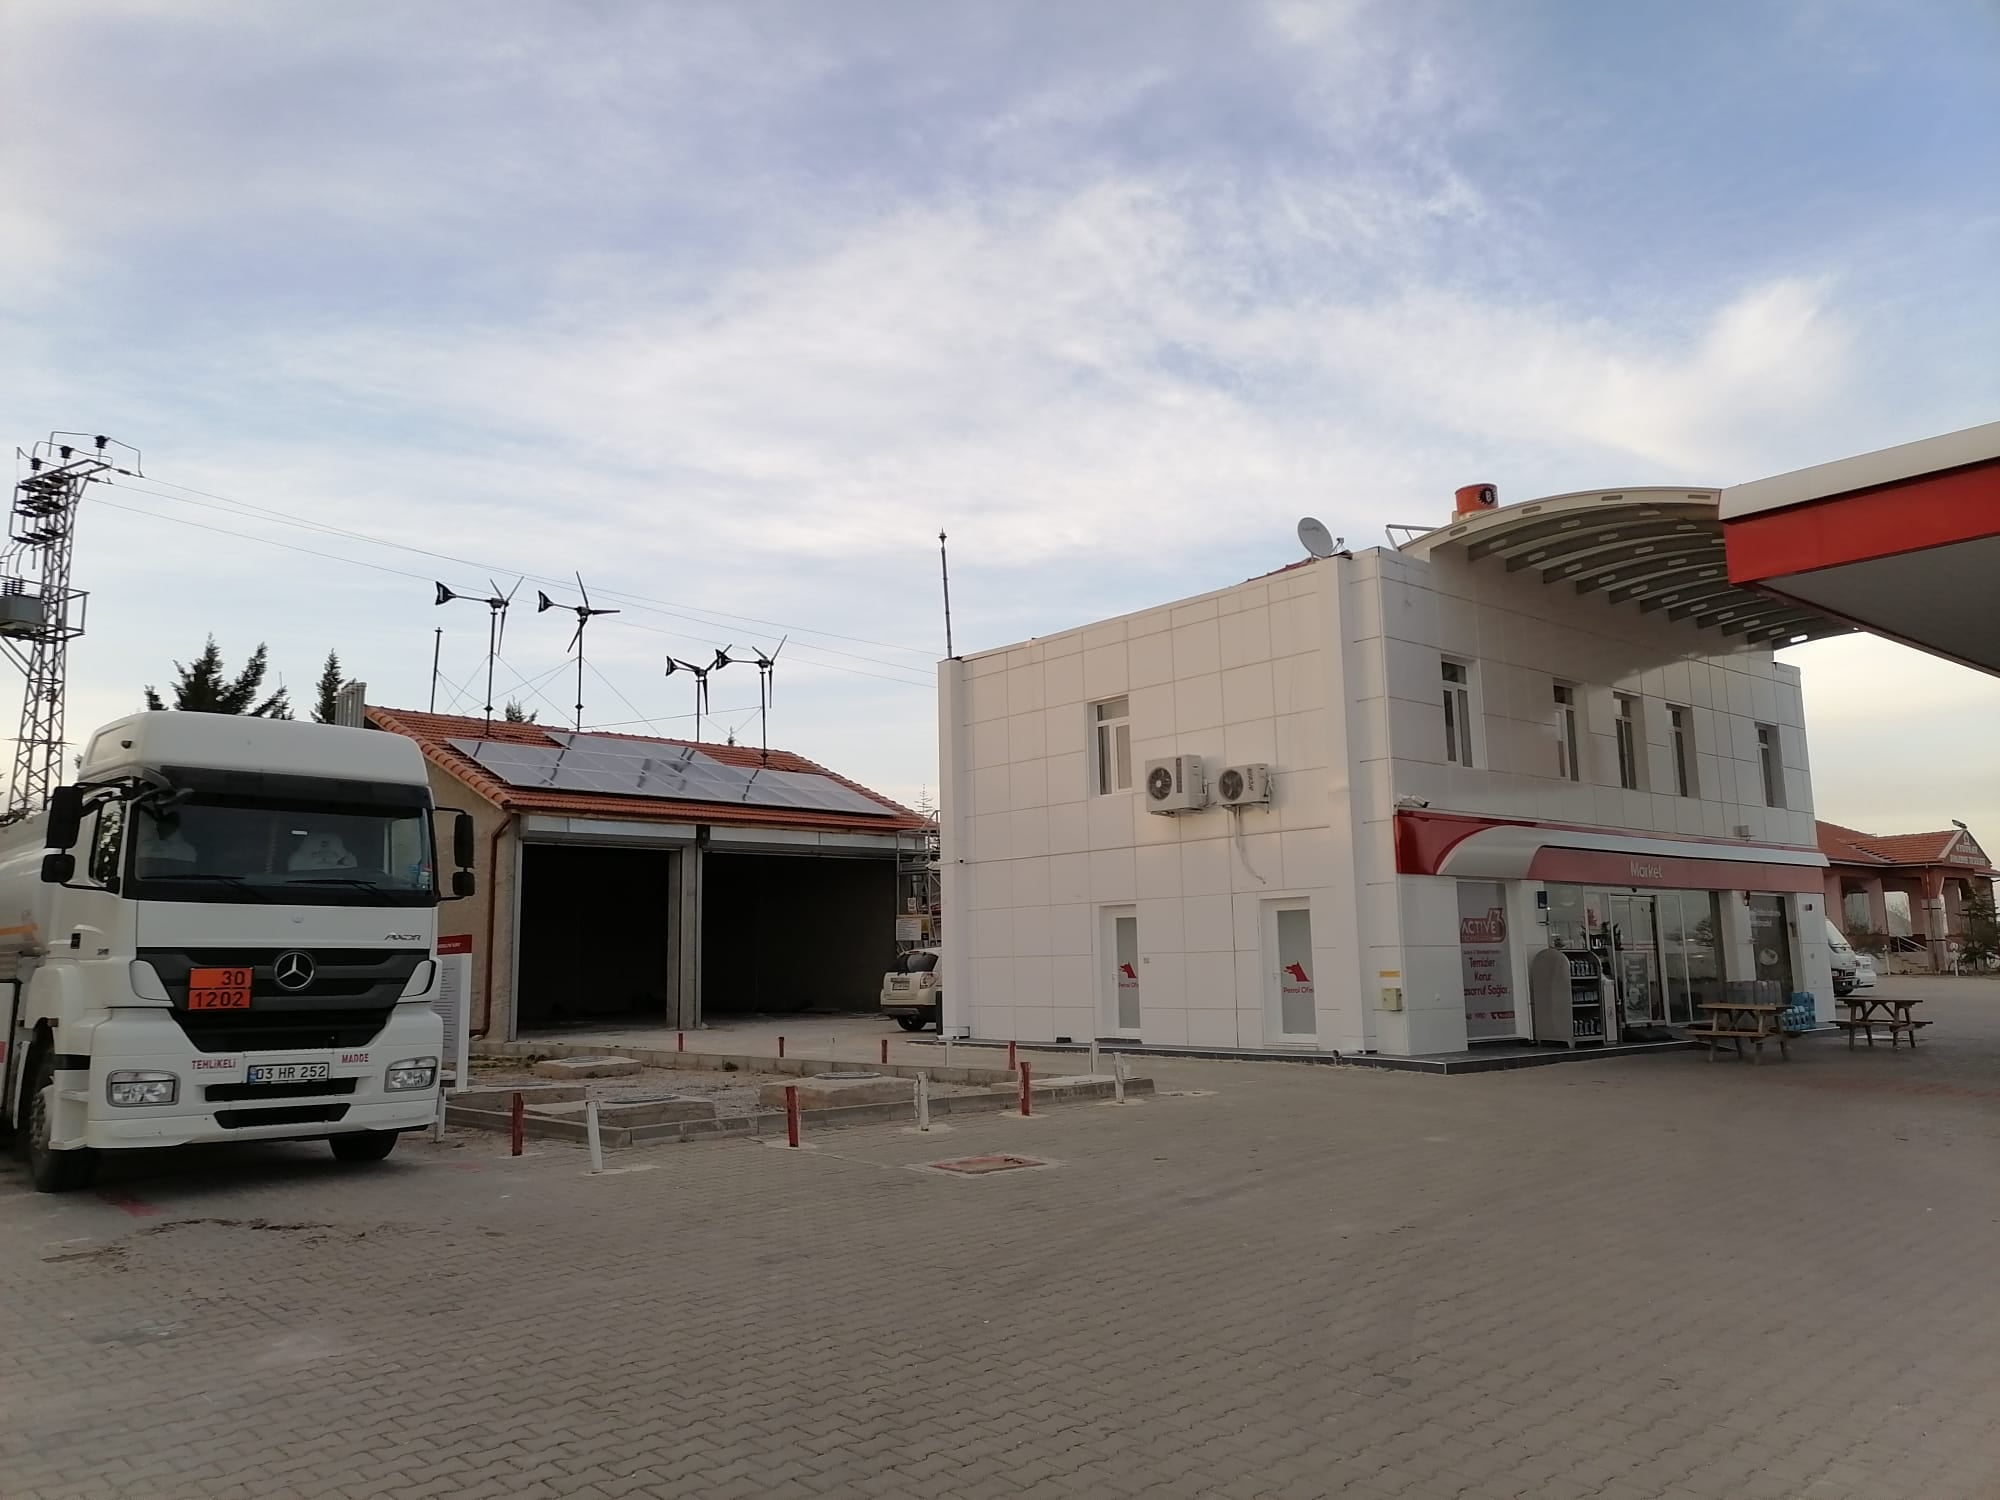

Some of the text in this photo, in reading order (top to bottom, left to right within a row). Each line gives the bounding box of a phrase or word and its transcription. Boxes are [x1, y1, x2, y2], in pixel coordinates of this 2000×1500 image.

[1630, 861, 1663, 878] Market
[1461, 918, 1497, 934] ACTIVE
[222, 970, 245, 986] 30
[1283, 986, 1301, 994] Petrol
[194, 991, 244, 1008] 1202
[341, 1053, 369, 1064] MADDE
[256, 1065, 326, 1080] 03 HR 252
